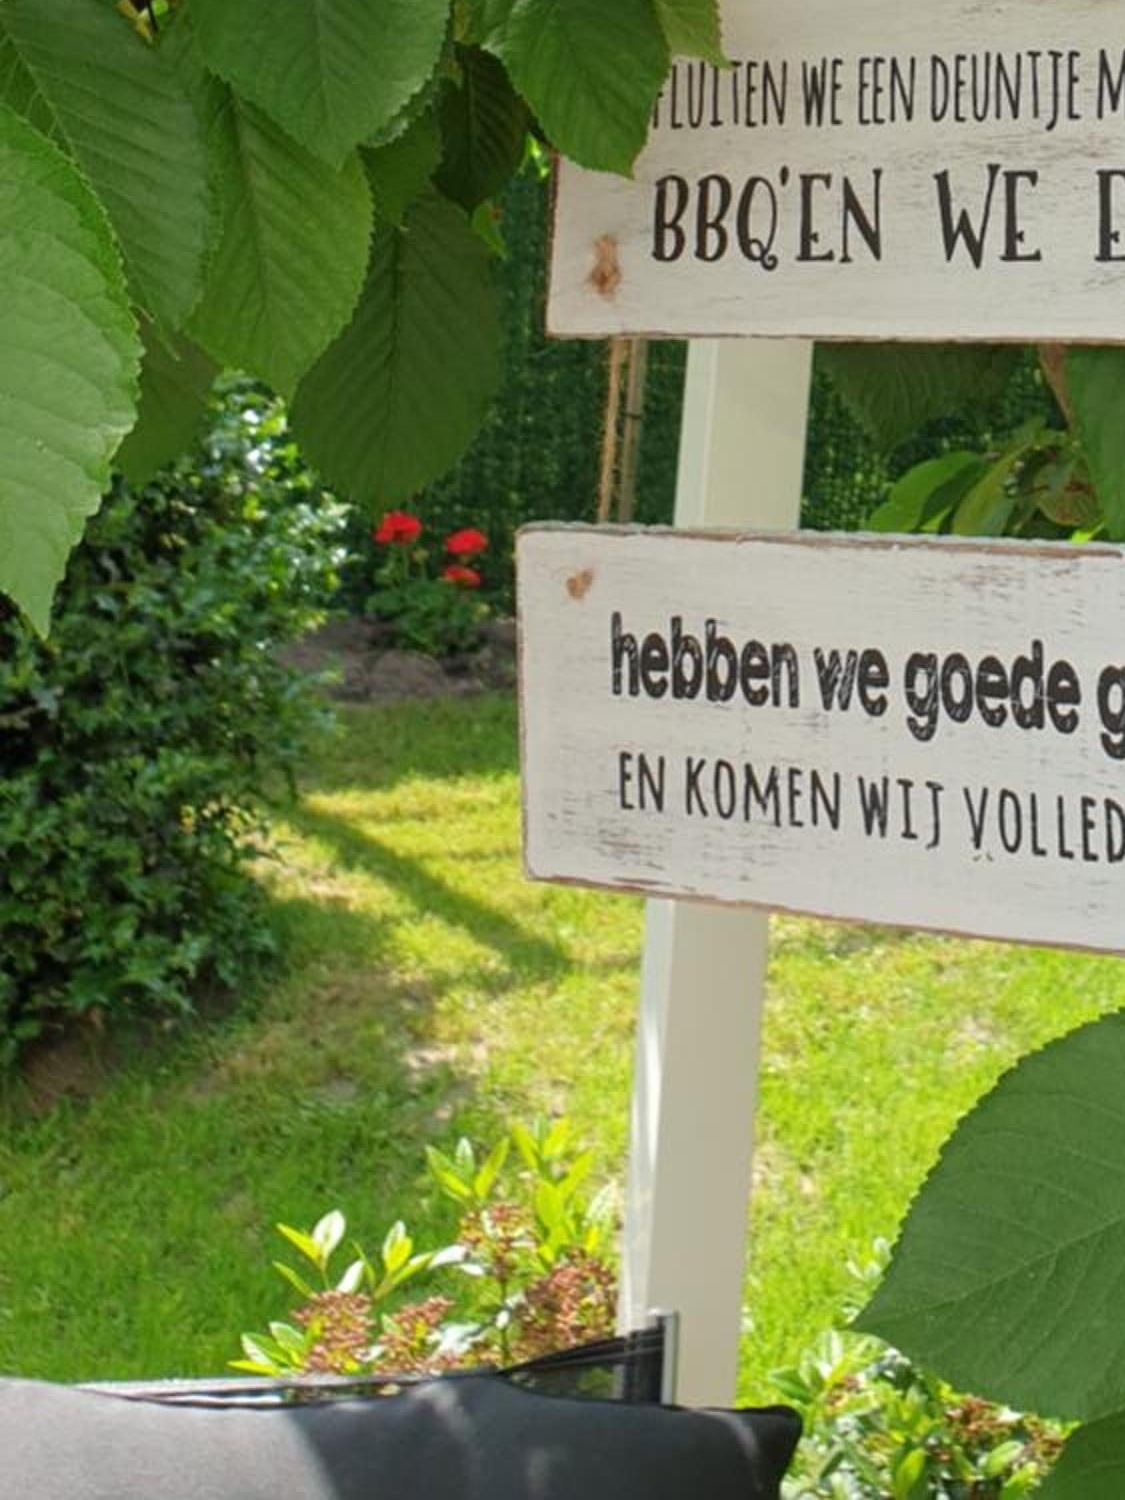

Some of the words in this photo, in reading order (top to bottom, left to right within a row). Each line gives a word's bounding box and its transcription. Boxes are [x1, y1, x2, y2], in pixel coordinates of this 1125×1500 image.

[801, 56, 844, 127] WE
[858, 55, 916, 125] EEN
[930, 50, 1082, 131] DEUNTJE
[650, 164, 884, 272] BBQ'EN
[932, 163, 1043, 270] WE
[610, 611, 800, 709] hebben
[813, 646, 891, 717] we
[903, 639, 1082, 743] goede
[617, 752, 666, 813] EN
[685, 757, 841, 831] KOMEN
[858, 773, 945, 850] WIJ
